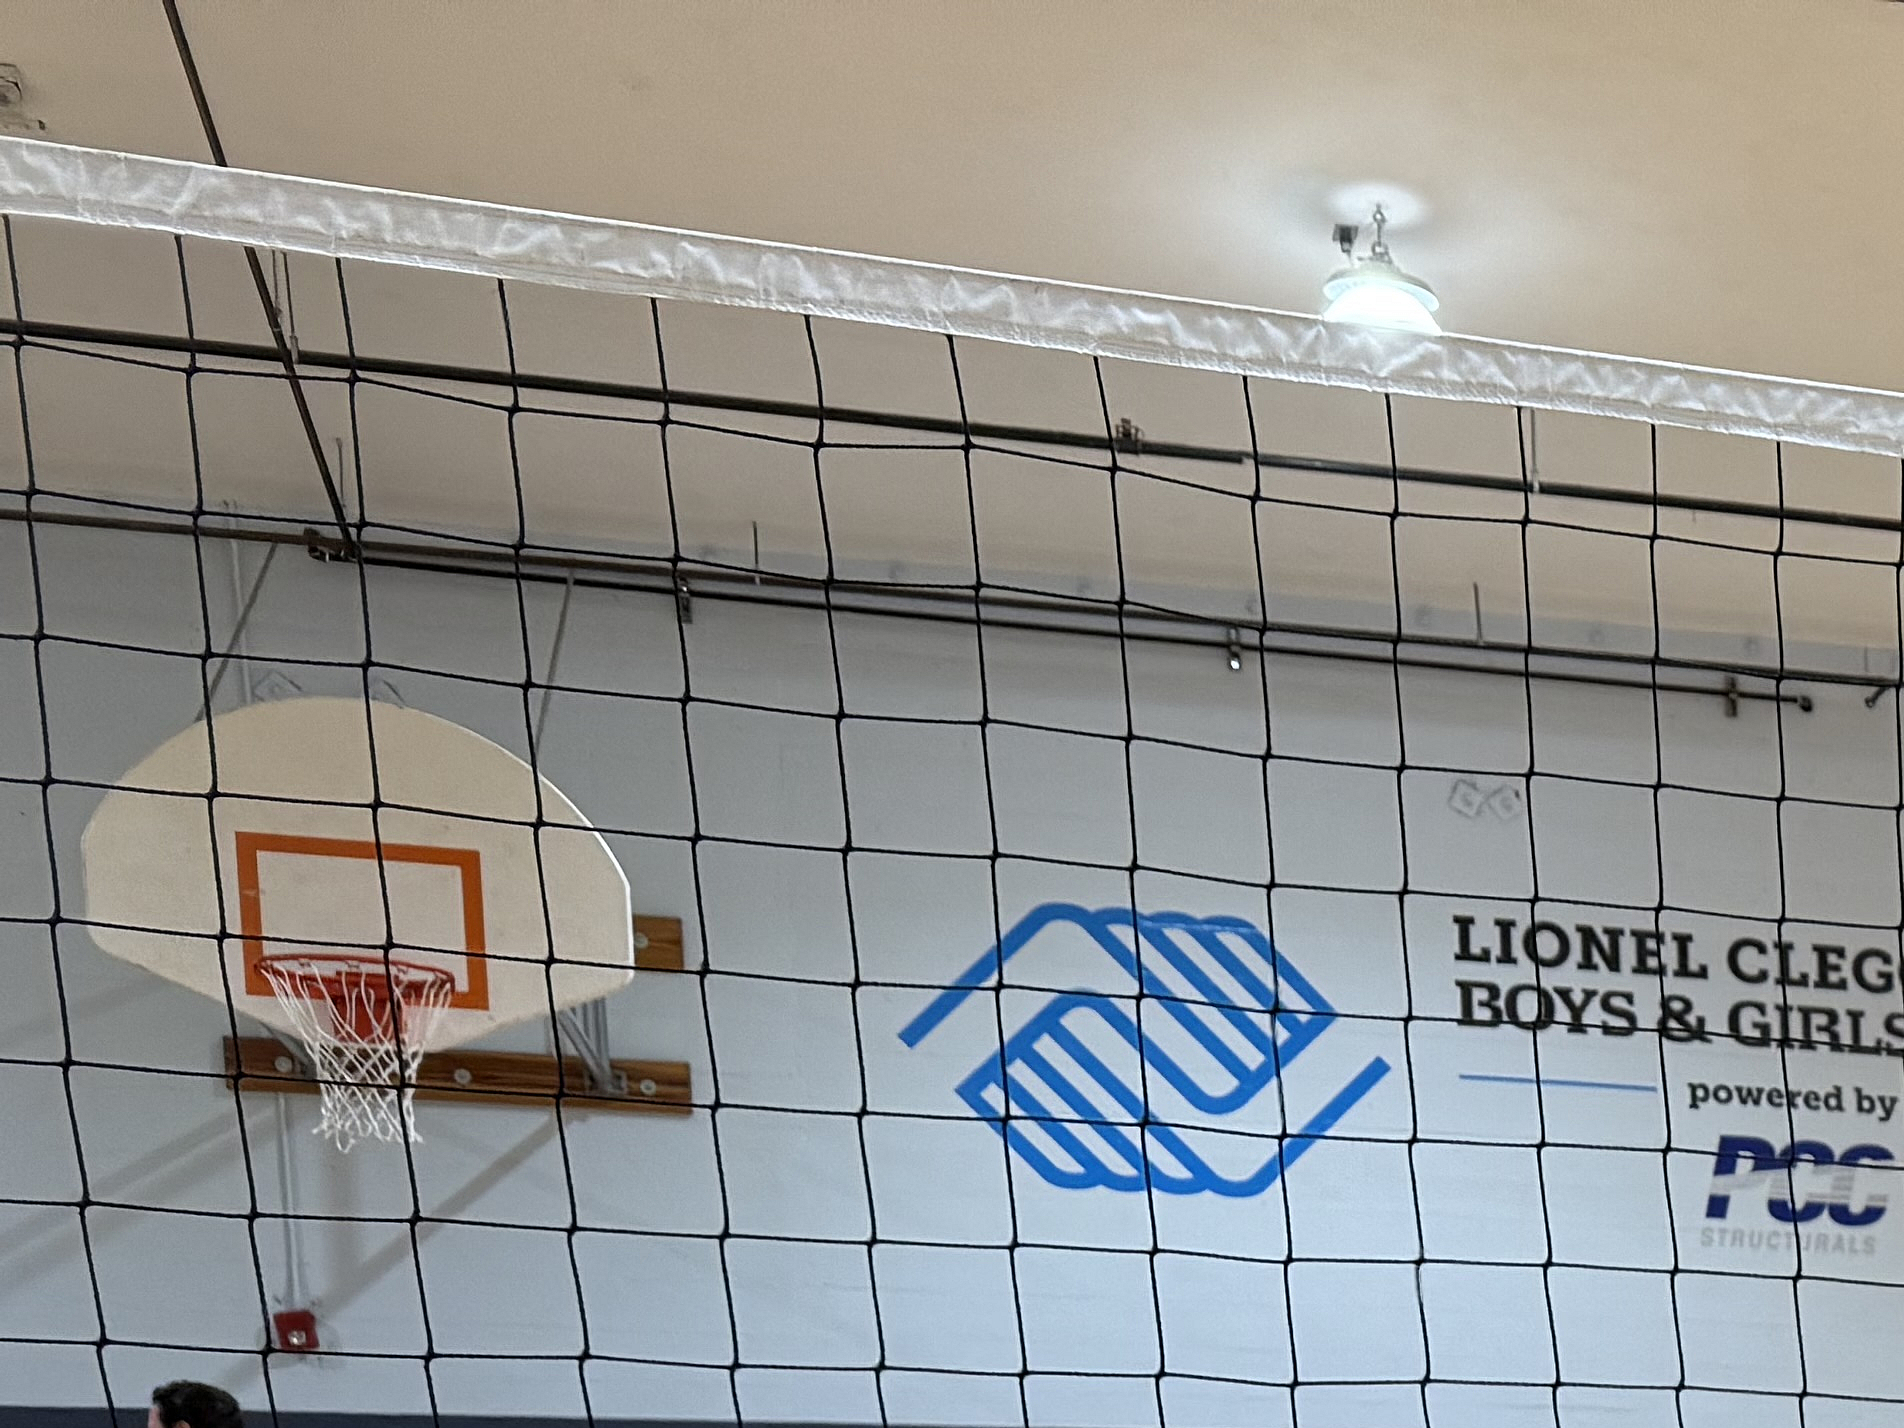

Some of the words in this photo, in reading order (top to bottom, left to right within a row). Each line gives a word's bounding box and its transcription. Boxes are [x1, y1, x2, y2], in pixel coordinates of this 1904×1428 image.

[1452, 914, 1708, 980] LIONEL
[1454, 979, 1637, 1036] BOYS
[1656, 994, 1713, 1042] &
[1687, 1082, 1844, 1112] powered
[1854, 1087, 1898, 1122] by
[1706, 1134, 1895, 1226] PCC
